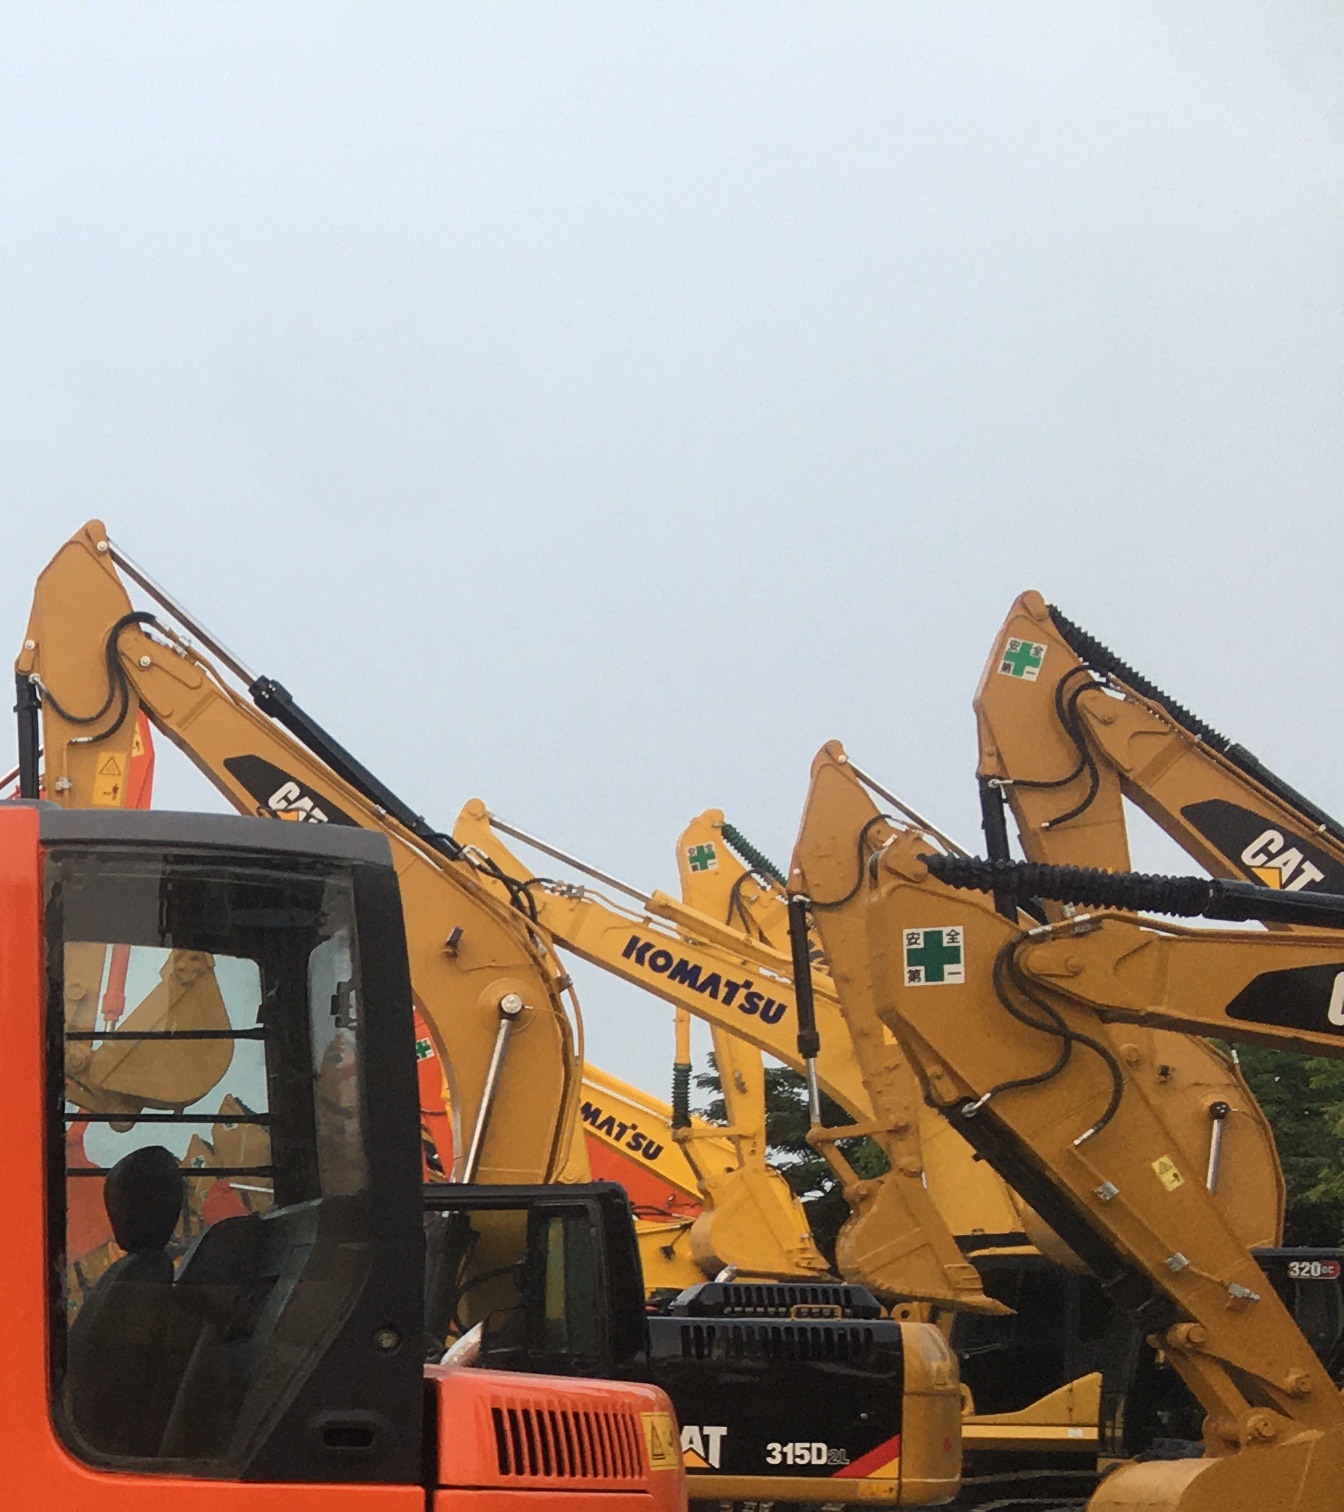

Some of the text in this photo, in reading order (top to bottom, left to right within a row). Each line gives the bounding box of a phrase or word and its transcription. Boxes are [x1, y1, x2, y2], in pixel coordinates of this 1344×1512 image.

[1241, 829, 1325, 891] CAT
[621, 935, 788, 1024] KOMATSU
[581, 1101, 664, 1160] MATSU
[1288, 1261, 1321, 1276] 320
[680, 1425, 727, 1469] AT
